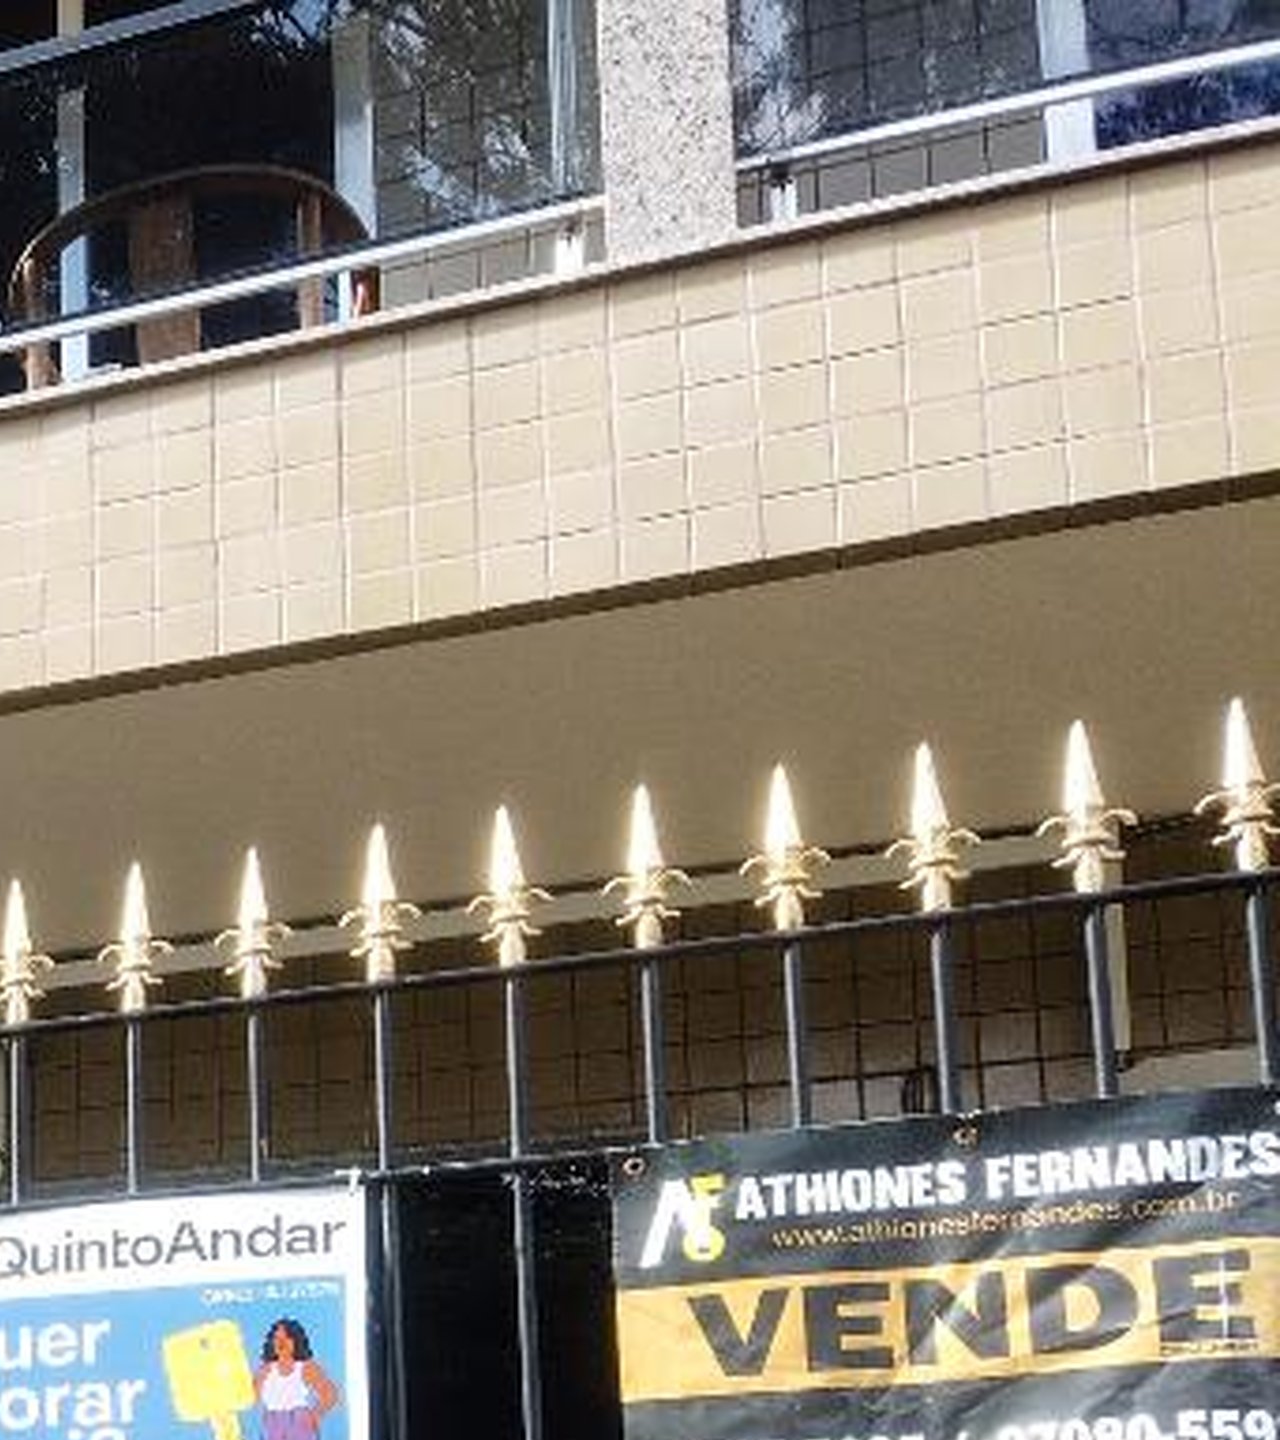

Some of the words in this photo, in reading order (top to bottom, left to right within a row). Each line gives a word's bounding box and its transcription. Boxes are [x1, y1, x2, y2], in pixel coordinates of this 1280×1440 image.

[734, 1158, 967, 1222] ATHIONES
[986, 1130, 1280, 1202] FERNANDES
[688, 1250, 1258, 1378] VENDE
